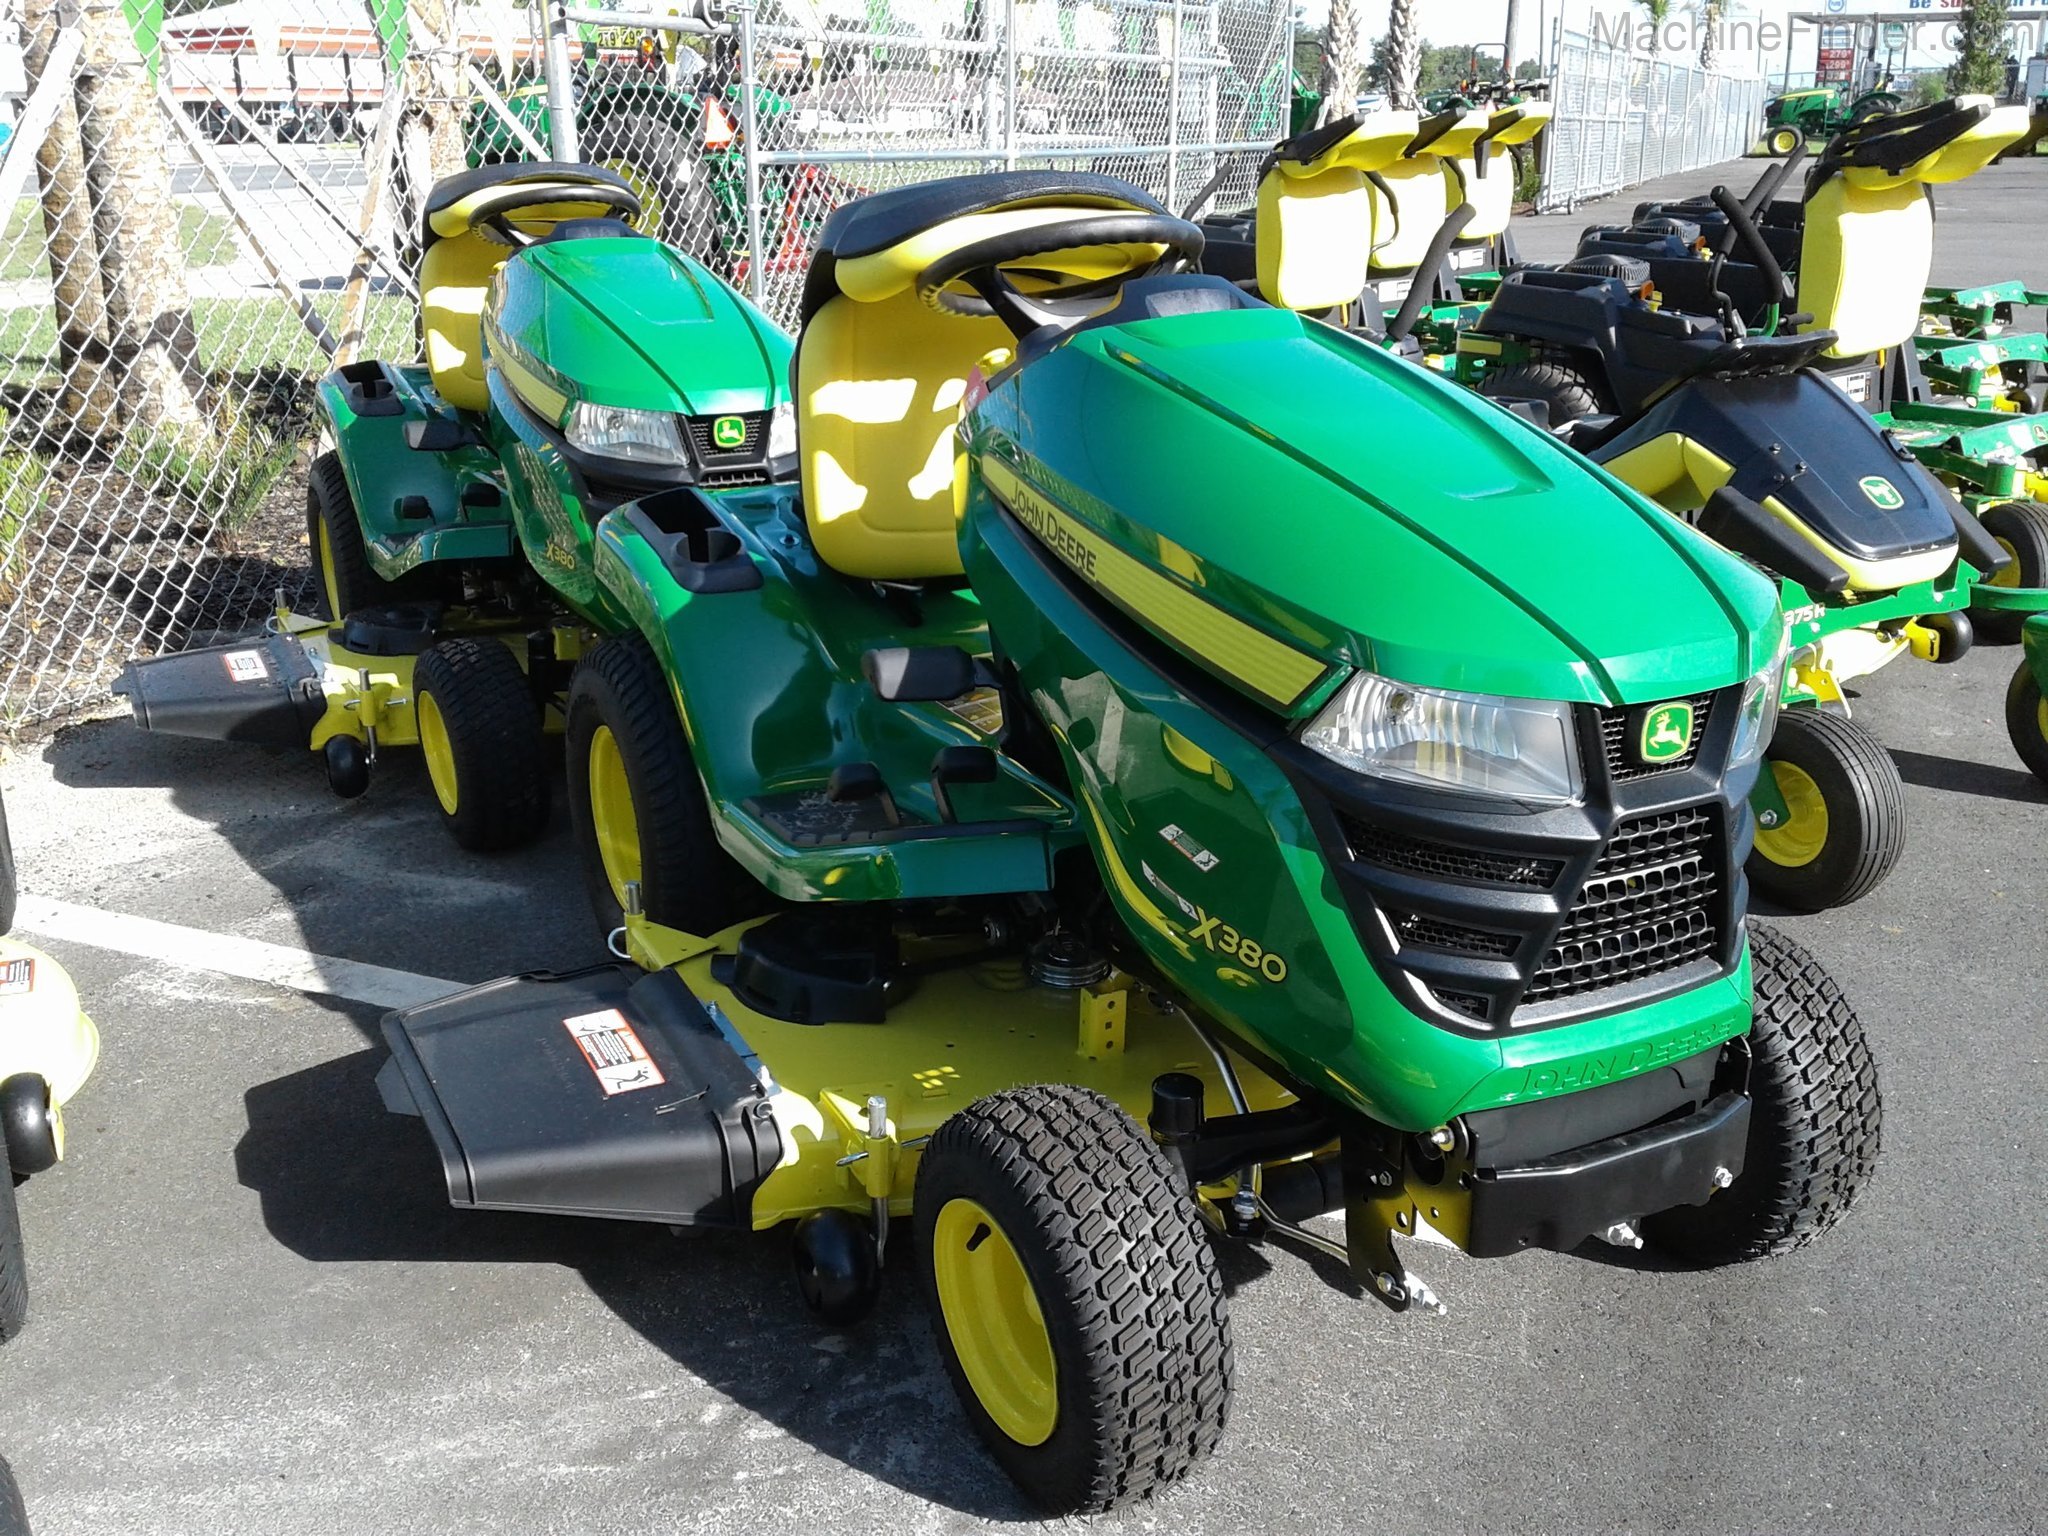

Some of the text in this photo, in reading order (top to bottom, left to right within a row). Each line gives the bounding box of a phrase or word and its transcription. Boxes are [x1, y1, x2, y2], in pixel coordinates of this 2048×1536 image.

[546, 540, 576, 570] X380
[1011, 482, 1097, 578] JOHN DEERE
[1188, 906, 1287, 982] X380
[1503, 1014, 1737, 1101] JOHN DEERE
